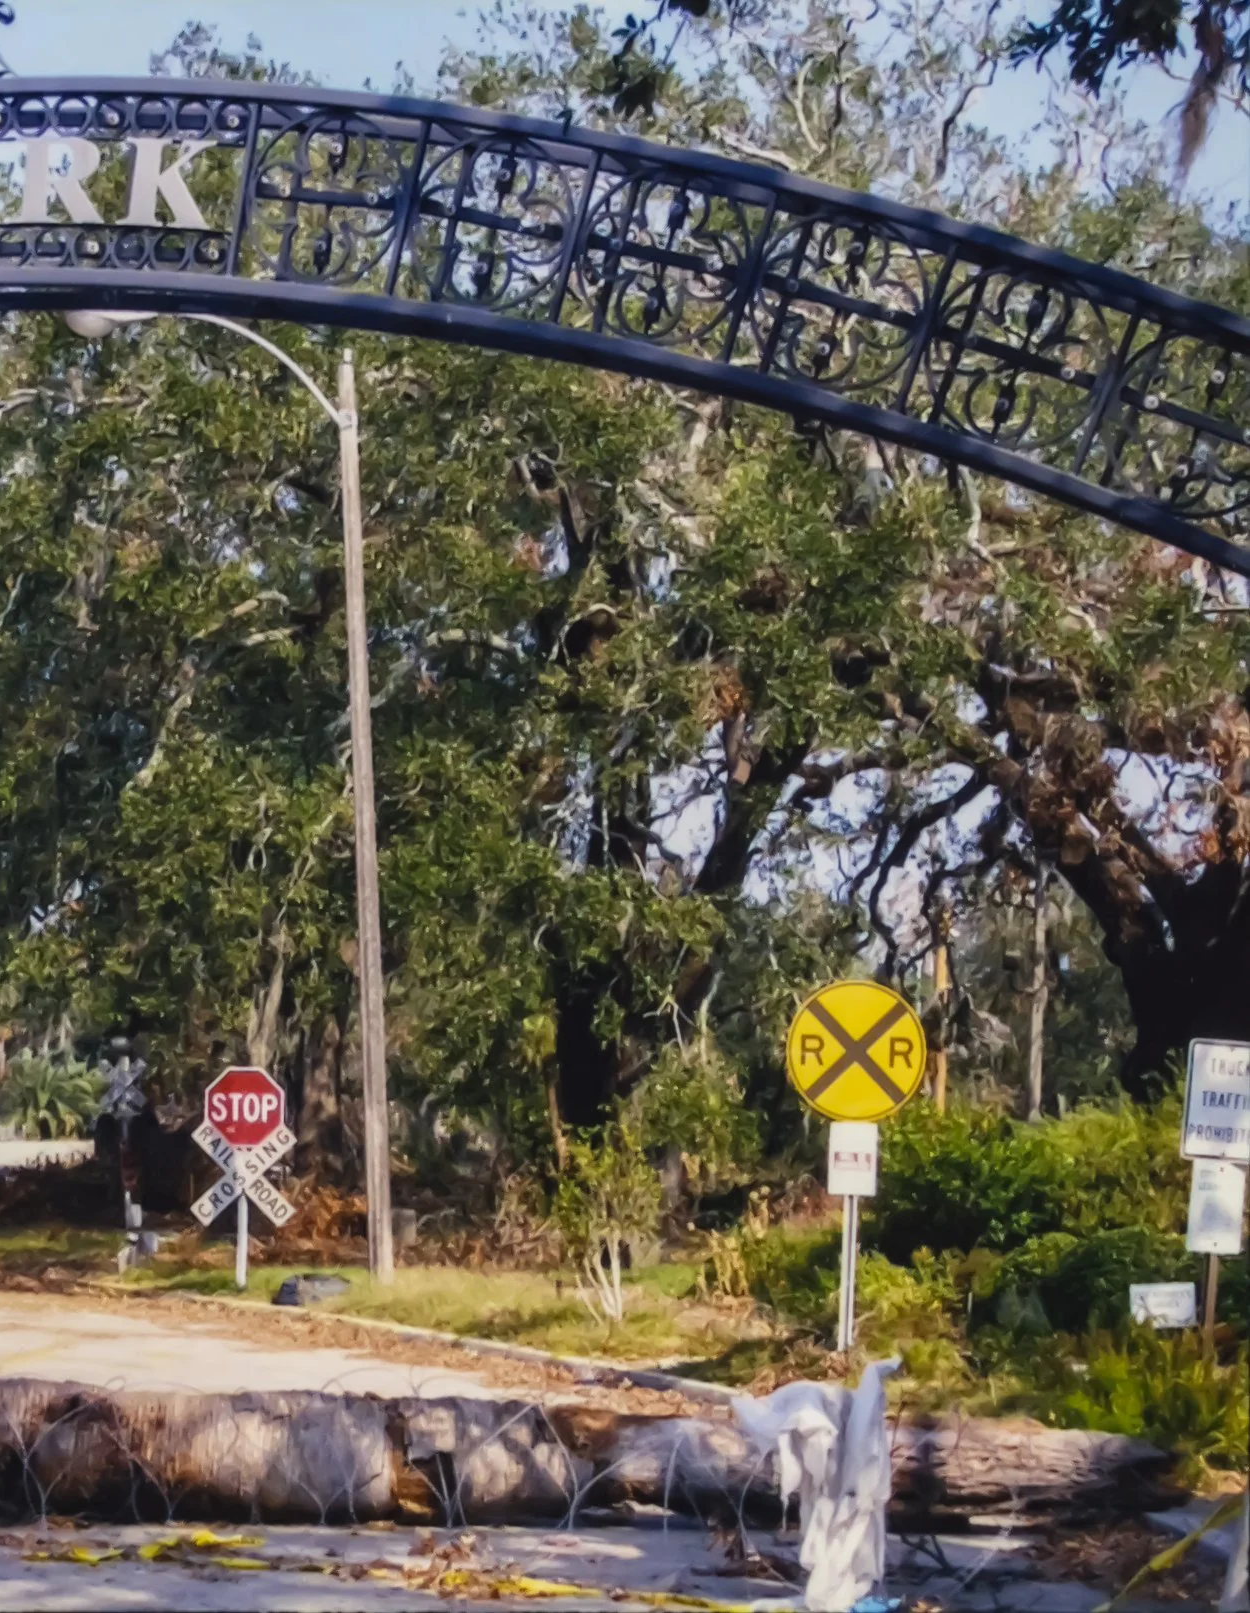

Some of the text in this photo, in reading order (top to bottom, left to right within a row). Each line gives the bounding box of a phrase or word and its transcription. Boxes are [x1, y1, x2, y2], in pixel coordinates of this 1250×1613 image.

[800, 1034, 825, 1066] R
[889, 1036, 914, 1069] R
[211, 1092, 277, 1123] STOP
